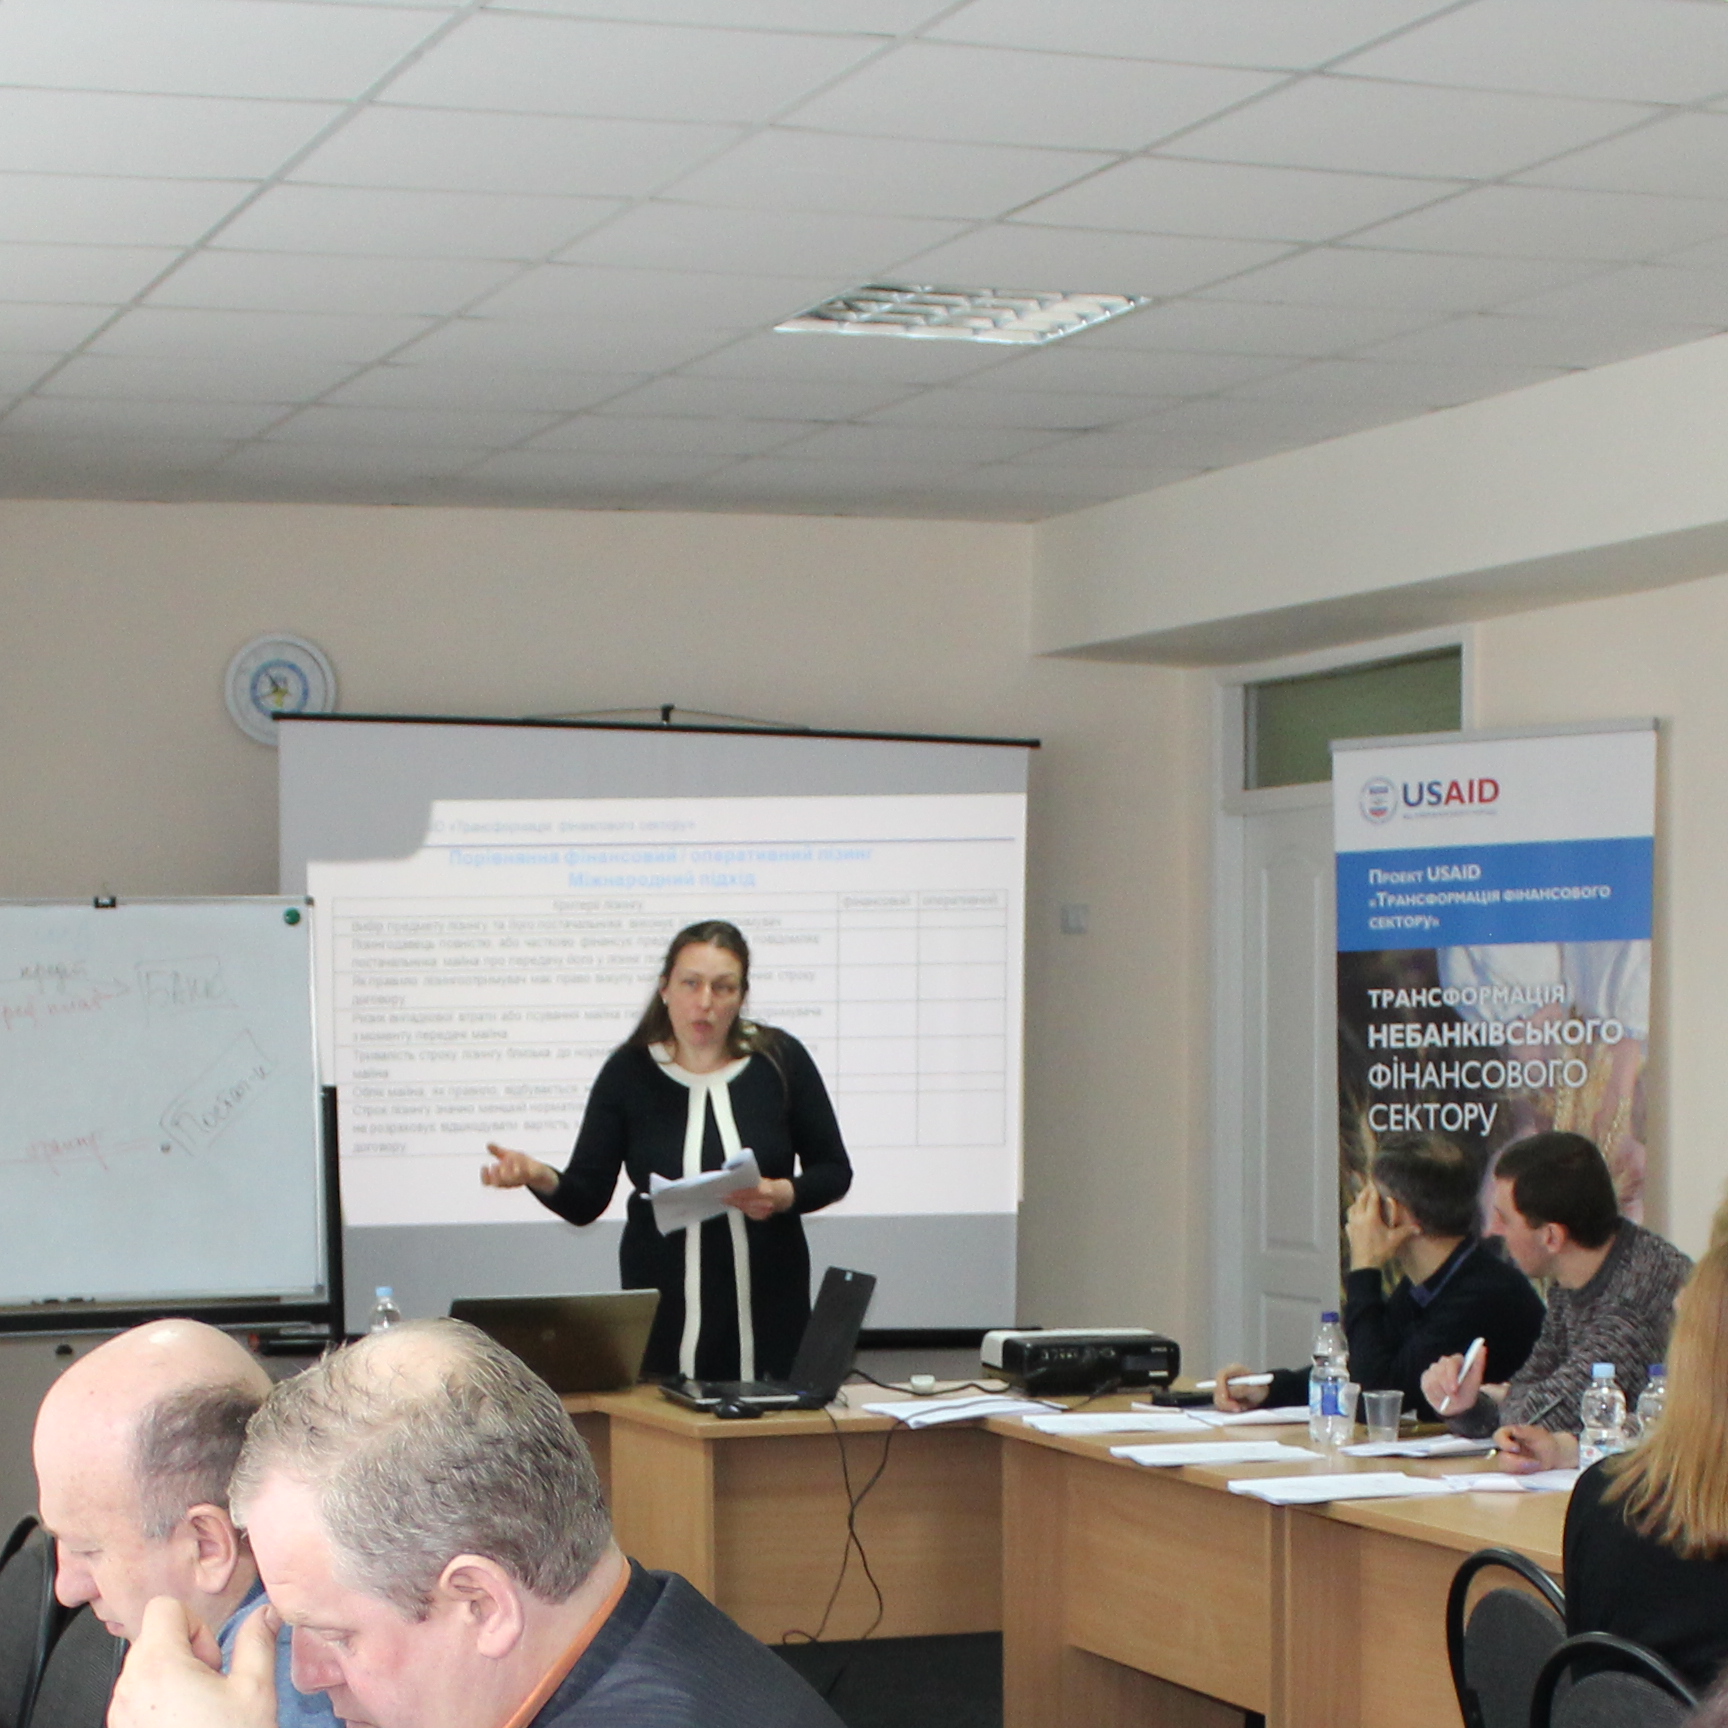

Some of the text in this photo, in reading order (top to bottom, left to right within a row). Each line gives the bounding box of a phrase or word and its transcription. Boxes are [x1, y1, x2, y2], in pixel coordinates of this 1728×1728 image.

[1402, 778, 1500, 808] USAID
[1427, 864, 1482, 882] USAID
[1368, 984, 1566, 1009] ТРАНСФОРМАЦІЯ
[1368, 1018, 1624, 1049] НЕБАНКІВСЬКОГО
[1368, 1056, 1589, 1089] ФІНАНСОВОГО
[1368, 1102, 1497, 1136] СЕКТОРУ
